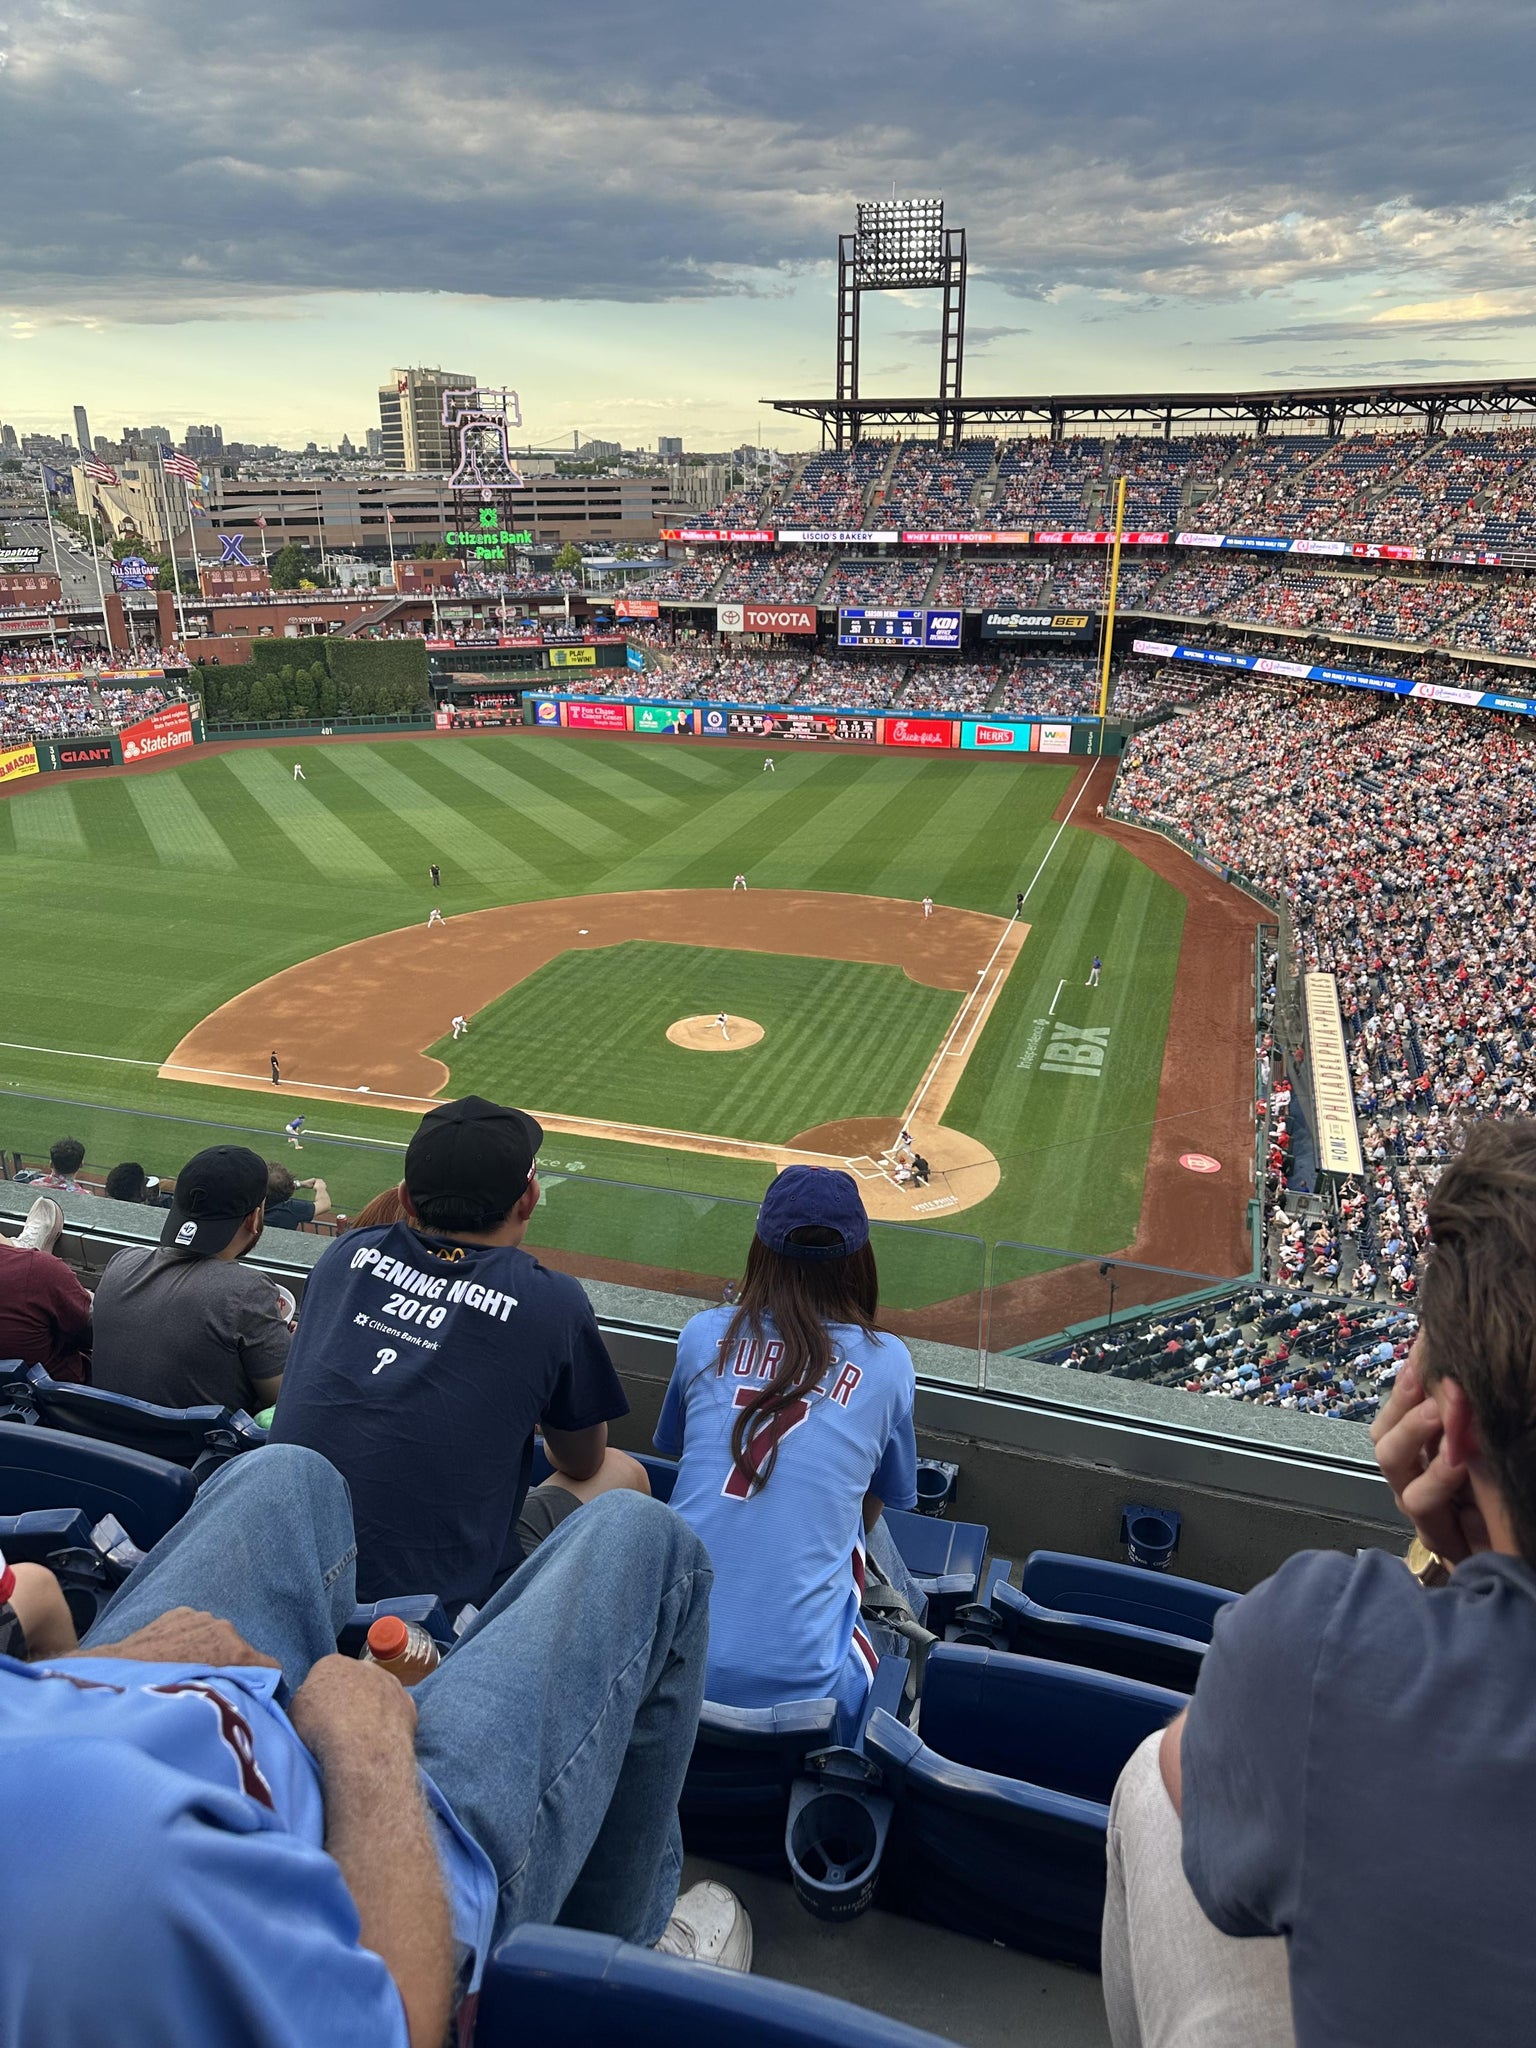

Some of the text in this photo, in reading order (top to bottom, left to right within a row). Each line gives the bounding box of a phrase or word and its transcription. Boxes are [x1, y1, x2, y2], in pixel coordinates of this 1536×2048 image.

[446, 530, 532, 545] Citizens Bank
[802, 532, 872, 541] LISCIO'S BAKERY
[476, 546, 505, 560] Park
[111, 565, 160, 576] ALL STAR GAME
[747, 611, 811, 627] TOYOTA
[931, 617, 959, 629] KDI
[986, 613, 1086, 627] theScore BET
[425, 640, 451, 648] udweiser
[512, 638, 538, 646] Budweiser
[596, 635, 622, 643] Budweiser
[577, 655, 592, 663] WIN!
[1384, 681, 1397, 689] FIRST
[581, 706, 615, 715] Fox Chase
[1495, 698, 1527, 710] INSPECTIONS
[321, 727, 333, 735] 401
[979, 729, 1010, 741] HERR'S
[49, 746, 57, 770] 387
[60, 748, 111, 763] GIANT
[1310, 977, 1337, 1023] PHILLIES
[1016, 1026, 1045, 1069] Independence
[1040, 1021, 1111, 1077] IBX
[1314, 1029, 1350, 1122] PHILADELPHIA
[1330, 1136, 1349, 1162] HOME
[350, 1247, 519, 1323] OPENING NGHT
[381, 1293, 448, 1330] 2019
[368, 1320, 439, 1351] Citizens Bank Park
[371, 1348, 398, 1375] P
[716, 1337, 864, 1409] TURR
[720, 1385, 813, 1502] 7
